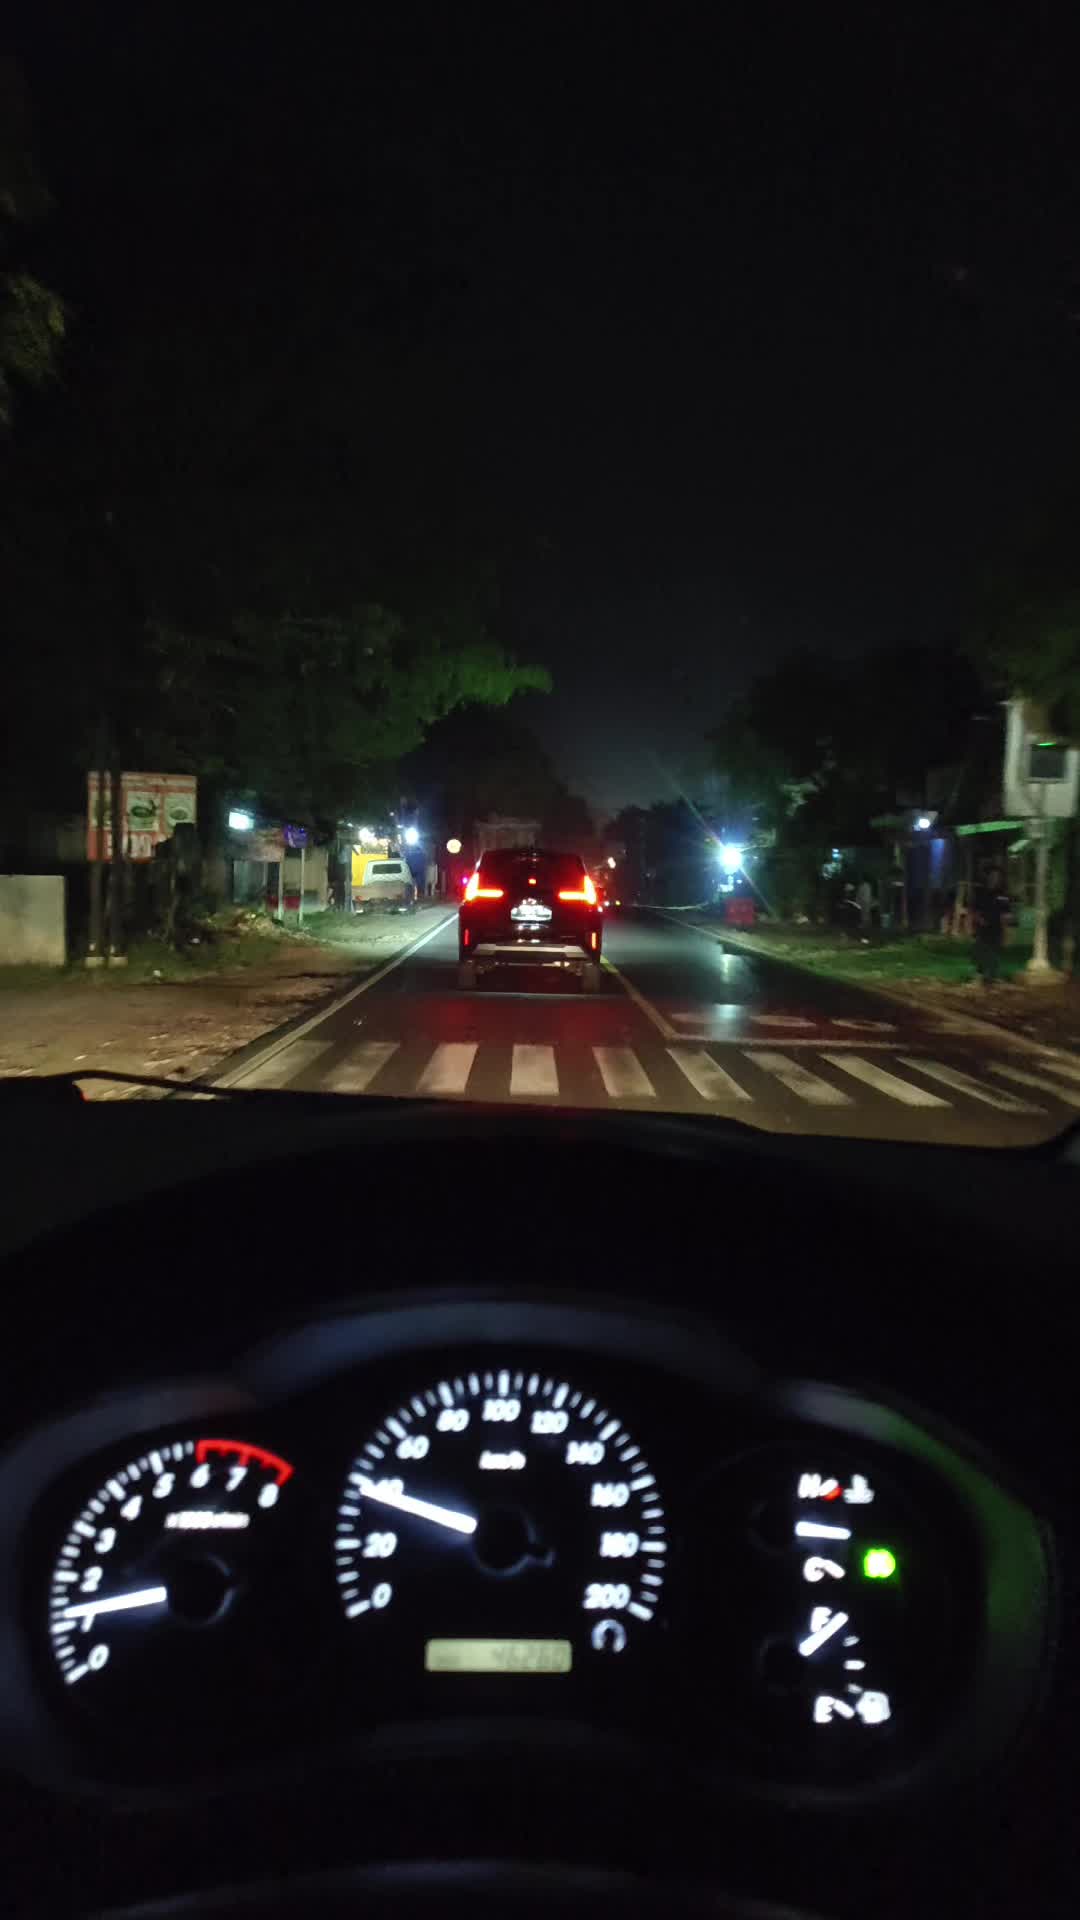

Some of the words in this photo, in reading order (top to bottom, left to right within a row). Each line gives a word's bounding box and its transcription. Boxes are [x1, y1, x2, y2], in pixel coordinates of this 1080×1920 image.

[226, 1465, 247, 1491] 7
[363, 1532, 397, 1558] 20
[80, 1566, 103, 1592] 2
[371, 1583, 392, 1609] 0
[583, 1584, 631, 1609] 200
[87, 1644, 109, 1671] 0
